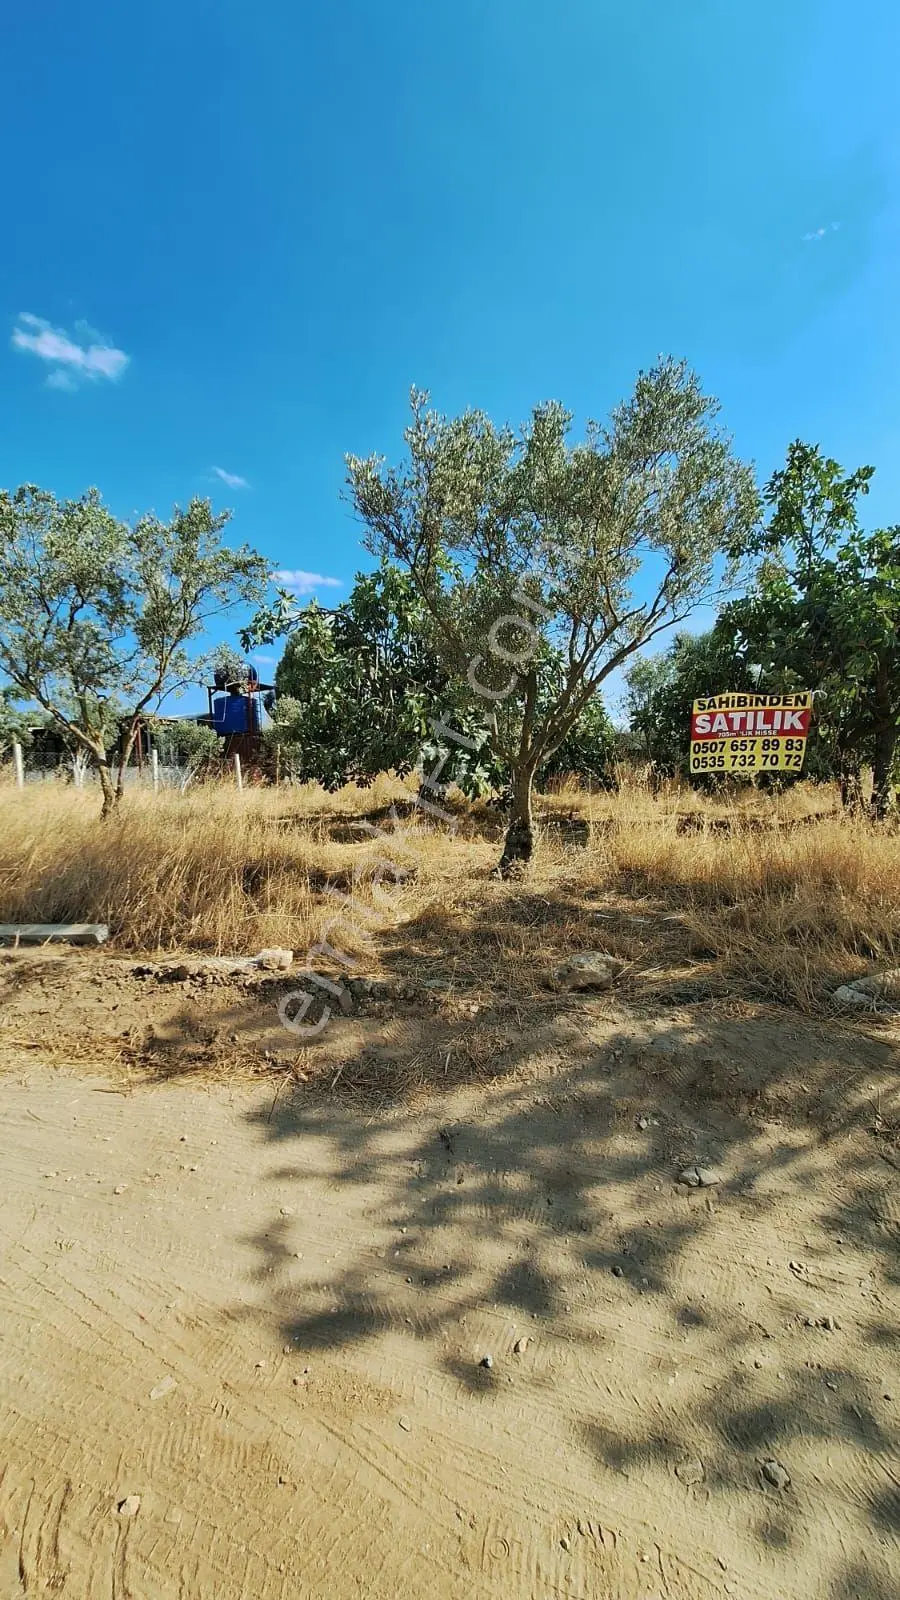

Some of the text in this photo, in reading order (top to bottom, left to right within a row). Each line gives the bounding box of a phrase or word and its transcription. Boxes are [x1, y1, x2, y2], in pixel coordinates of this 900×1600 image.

[695, 710, 804, 734] SATILIK
[693, 739, 804, 754] 0507 657 89 83
[692, 754, 802, 769] 0535 732 70 72
